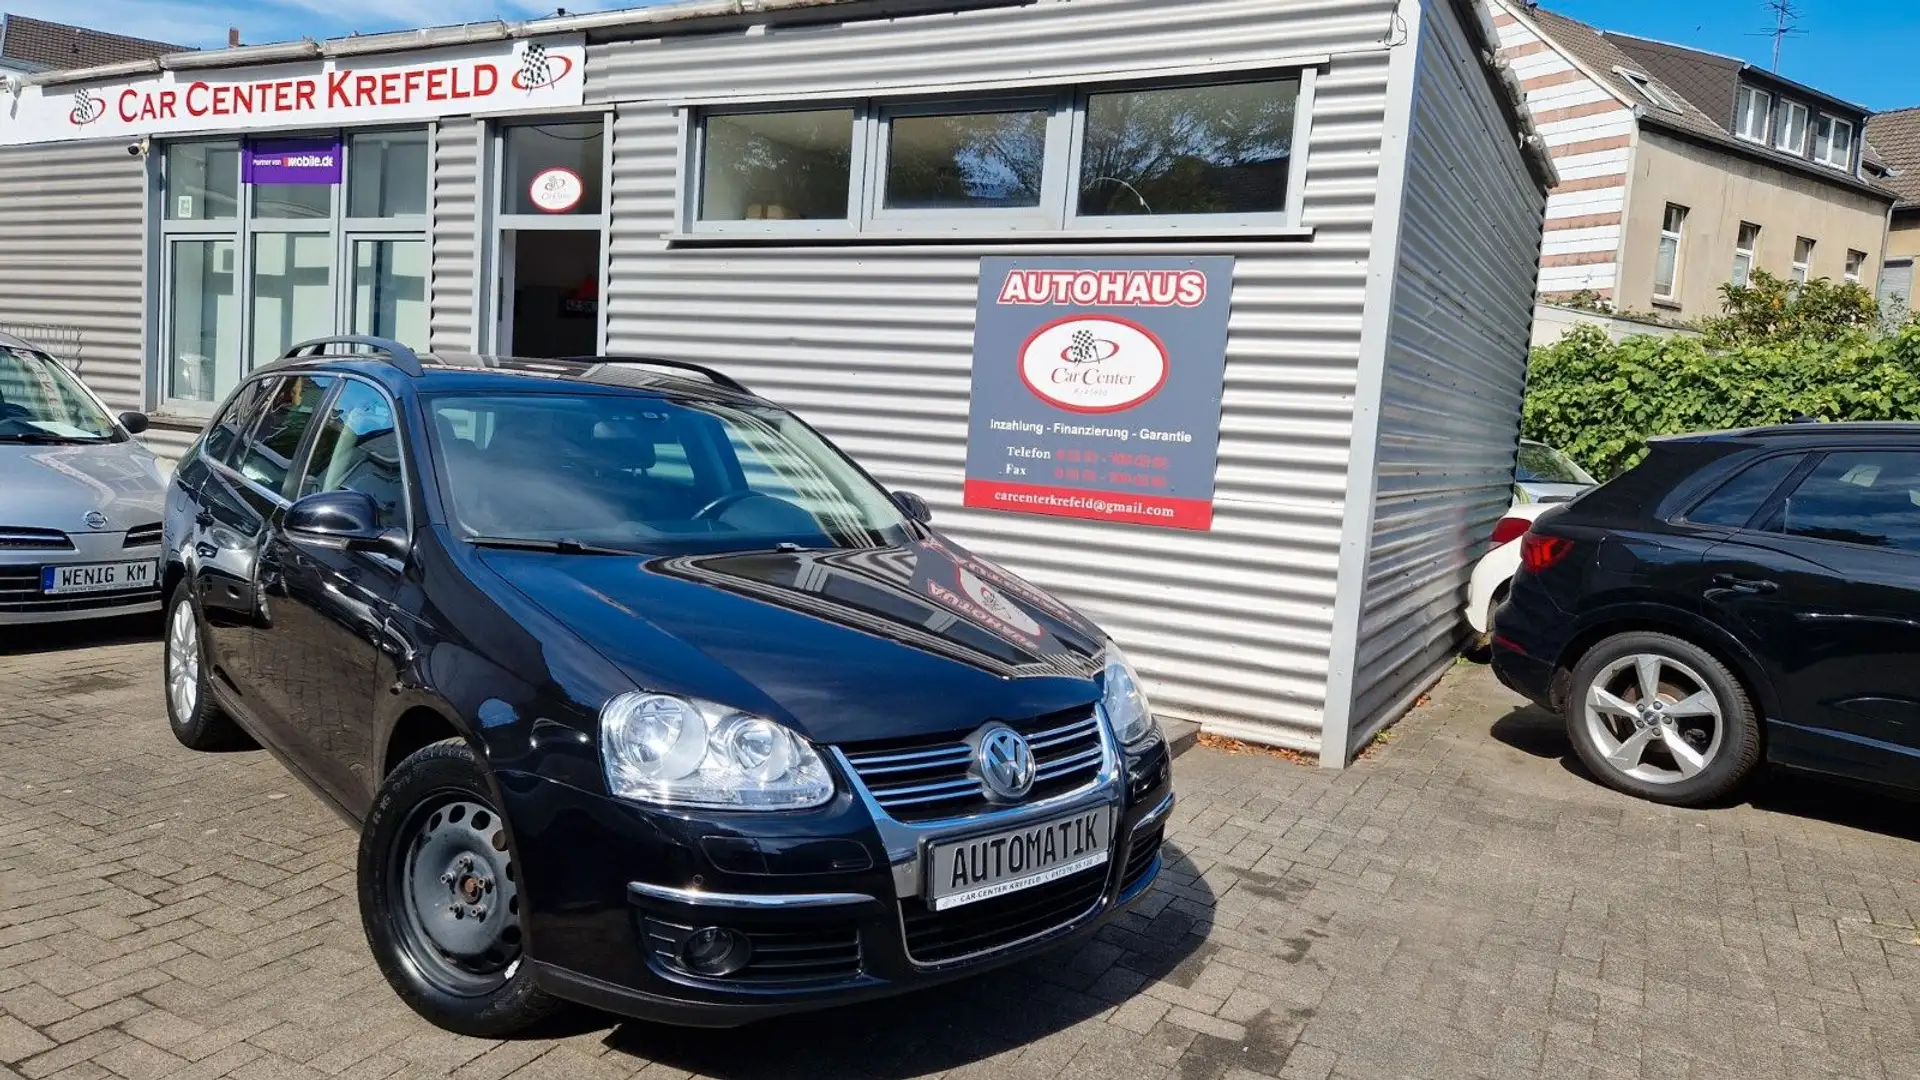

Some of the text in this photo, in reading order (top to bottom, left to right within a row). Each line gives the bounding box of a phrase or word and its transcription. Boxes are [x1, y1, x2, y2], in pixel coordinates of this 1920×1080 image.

[119, 63, 499, 122] CAR CENTER KREFELD
[997, 269, 1207, 307] AUTOHAUS
[1051, 367, 1136, 386] Car Center
[990, 418, 1044, 435] Inzahlung
[1053, 422, 1129, 441] Finanzierung
[1139, 428, 1193, 443] Garantie
[1006, 446, 1051, 460] Telefon
[1005, 463, 1027, 476] Fax
[994, 490, 1175, 518] carcenterkrefeld@gmail.com
[62, 564, 148, 586] WENIG KM
[951, 812, 1098, 888] AUTOMATIK
[960, 890, 977, 902] CAR
[978, 883, 1008, 898] CENTER
